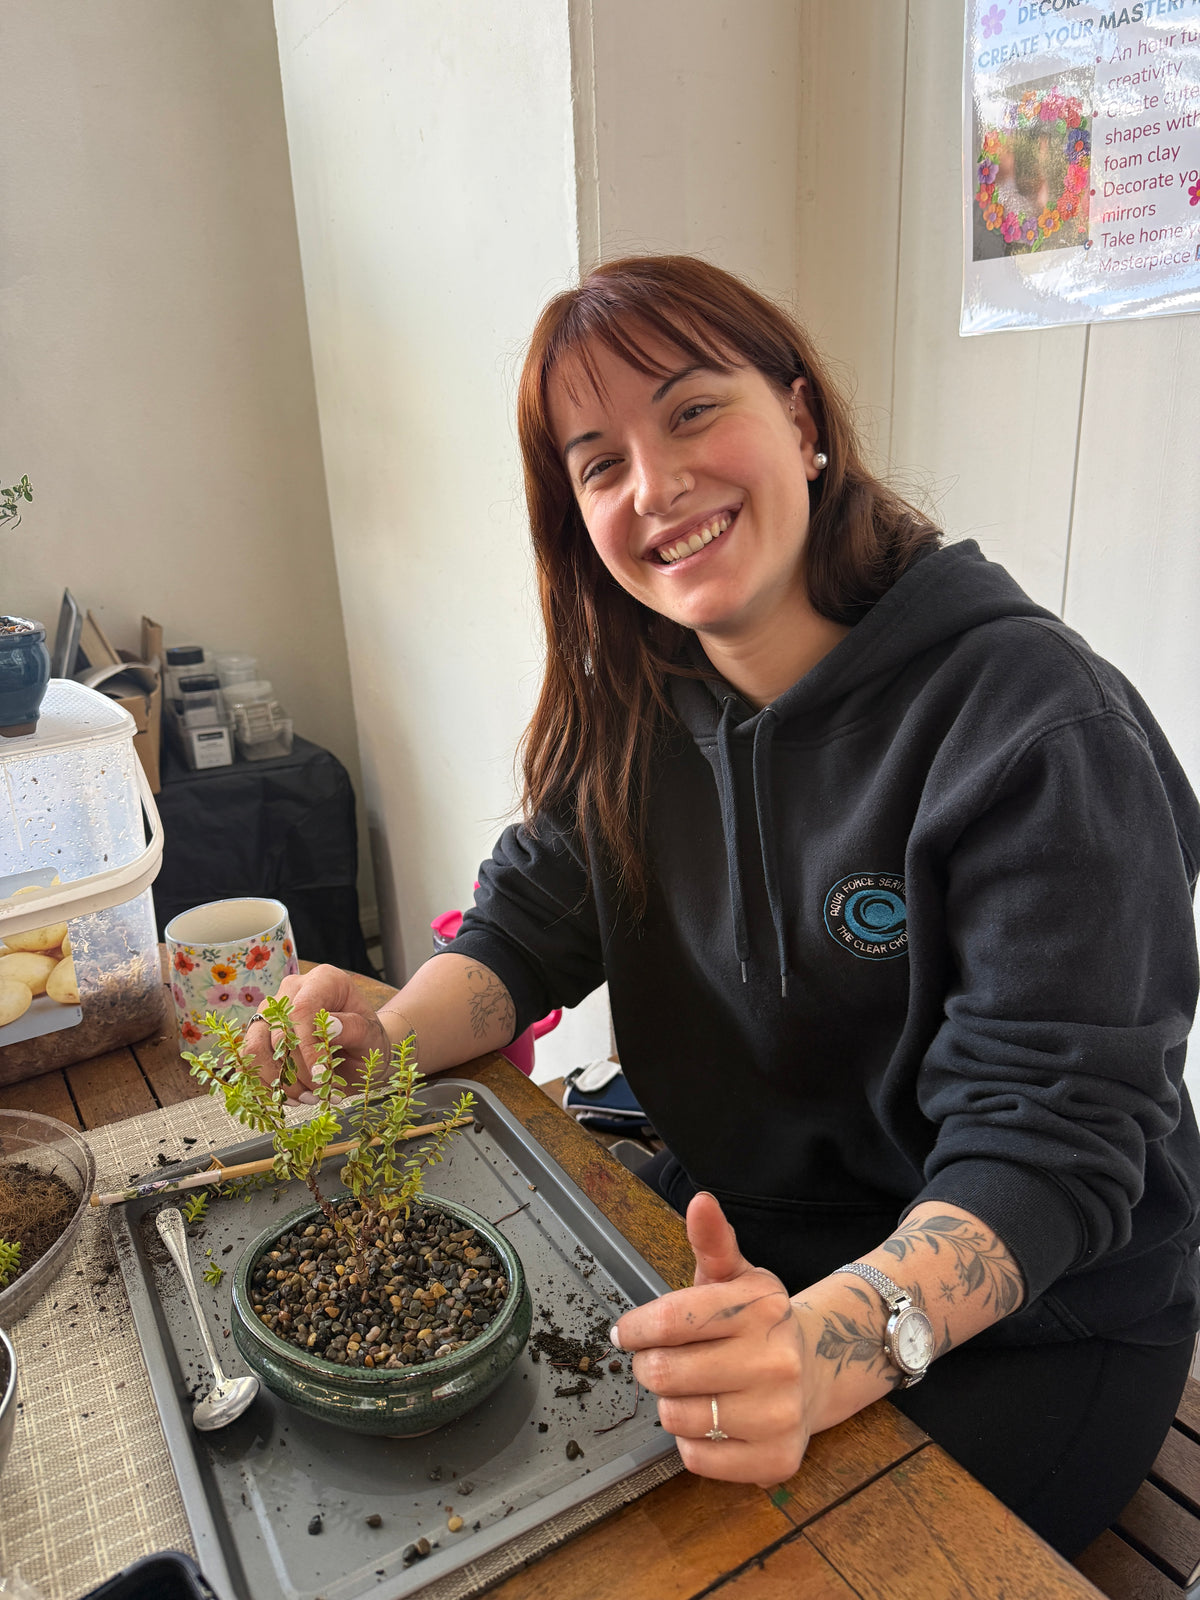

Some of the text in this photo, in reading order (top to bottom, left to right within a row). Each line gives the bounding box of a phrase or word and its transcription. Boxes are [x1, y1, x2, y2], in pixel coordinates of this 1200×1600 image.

[978, 34, 1040, 68] CREATE
[1045, 18, 1094, 48] YOUR
[1109, 28, 1200, 65] An hour fu
[1108, 59, 1183, 92] creativity
[1163, 85, 1200, 105] cute
[1105, 122, 1161, 145] shapes
[1104, 145, 1181, 172] foam clay
[1103, 173, 1174, 198] Decorate
[1102, 204, 1156, 224] mirrors
[1101, 230, 1135, 248] Take
[1140, 226, 1184, 243] home
[1099, 250, 1191, 273] Masterpiece
[829, 891, 846, 917] AQUA
[842, 877, 875, 894] FORCE
[836, 925, 855, 943] THE
[853, 939, 888, 954] CLEAR
